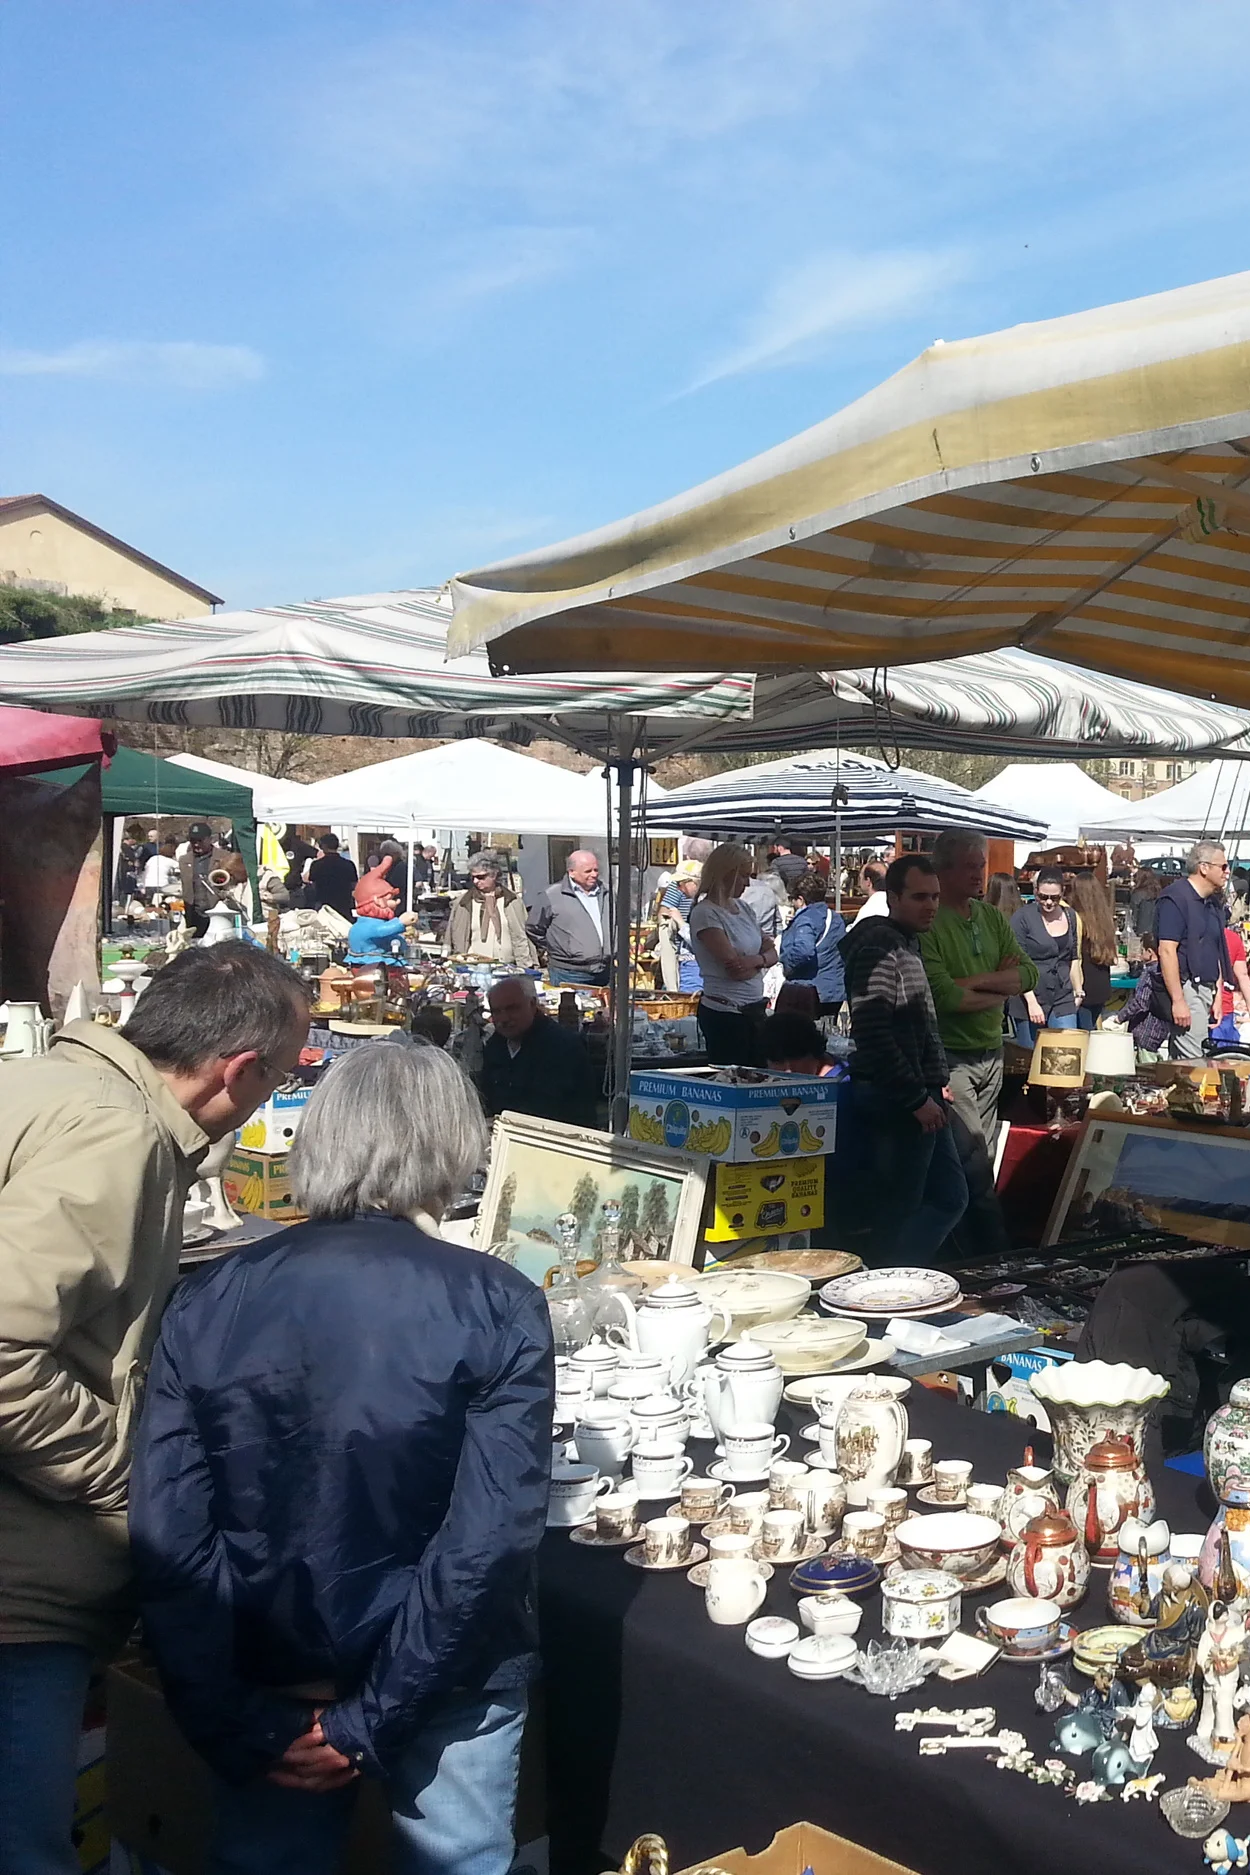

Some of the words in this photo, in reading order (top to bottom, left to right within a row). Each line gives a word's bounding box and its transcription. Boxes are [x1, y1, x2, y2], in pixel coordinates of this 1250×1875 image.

[639, 1080, 677, 1096] PREMIUM
[682, 1085, 723, 1102] BANANAS
[748, 1087, 789, 1099] PREMIUM
[792, 1085, 829, 1097] BANANAS
[791, 1178, 819, 1187] PREMIUM
[792, 1185, 817, 1193] QUALITY
[1001, 1353, 1042, 1371] BANANAS
